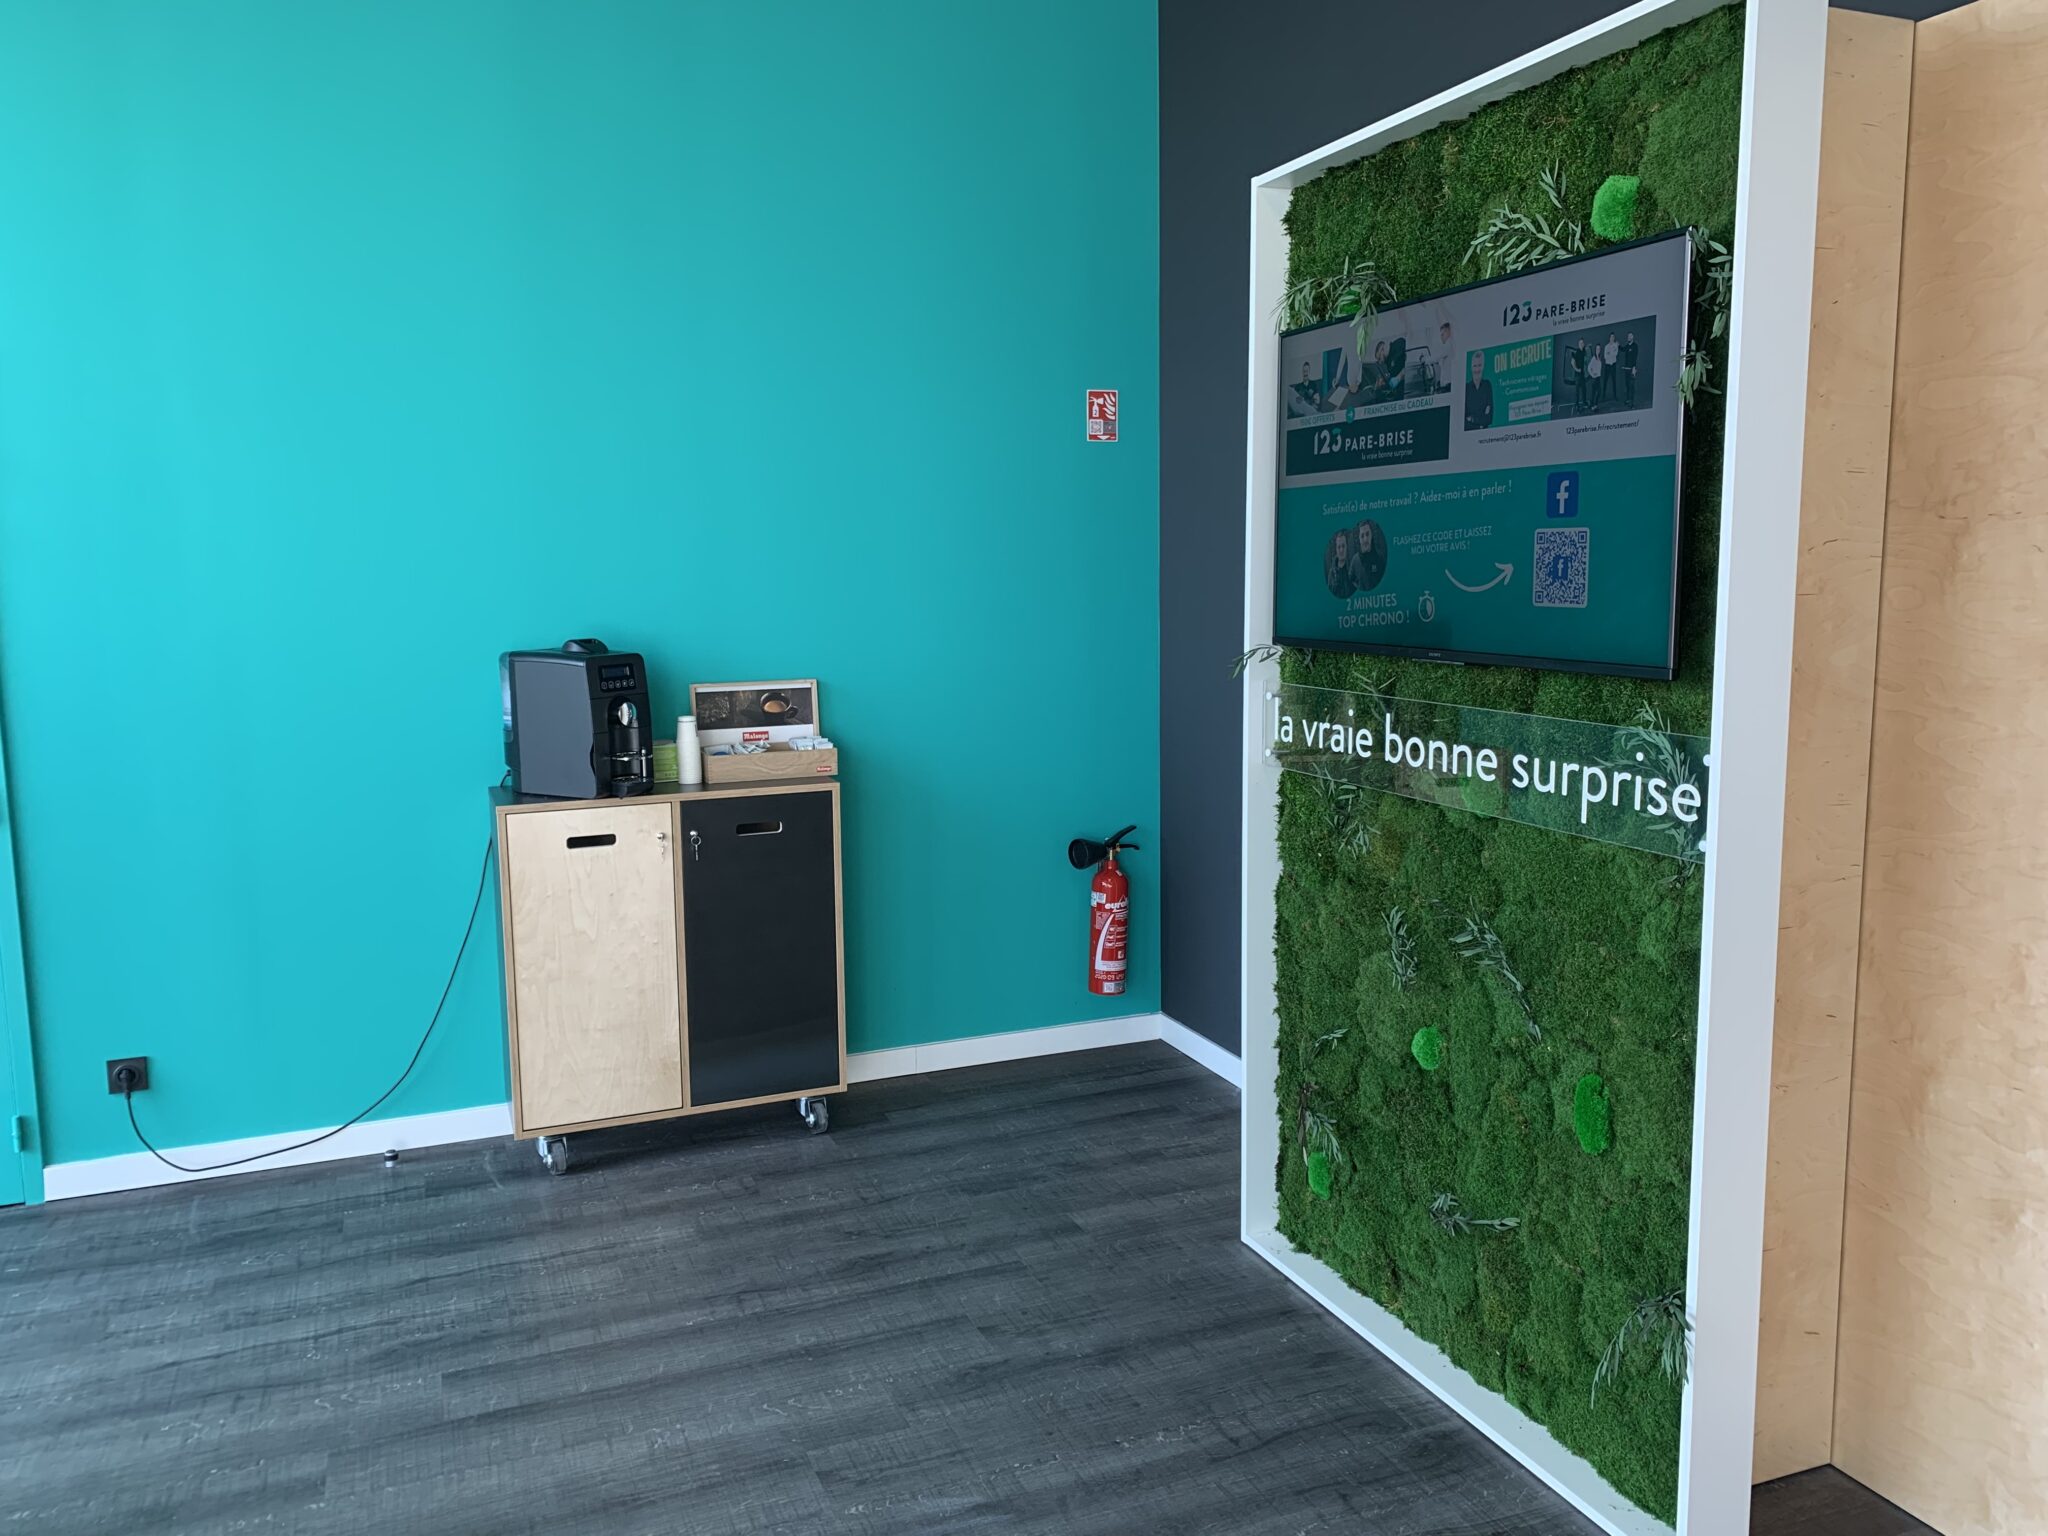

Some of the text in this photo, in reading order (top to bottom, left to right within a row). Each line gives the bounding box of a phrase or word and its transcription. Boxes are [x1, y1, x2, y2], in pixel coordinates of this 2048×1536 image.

[1536, 294, 1606, 320] PARE-BRISE
[1494, 338, 1552, 374] ON RECRUTE
[1363, 401, 1397, 416] FRANCHISE
[1407, 396, 1434, 409] CADEAU
[1345, 429, 1414, 452] PARE-BRISE
[1322, 500, 1358, 516] Satisfait(e)
[1359, 500, 1368, 511] de
[1369, 499, 1388, 510] notre
[1389, 492, 1412, 506] travail
[1420, 487, 1460, 503] Aidez-moi
[1462, 486, 1467, 498] à
[1469, 488, 1479, 498] en
[1481, 481, 1506, 501] parler
[1393, 525, 1492, 546] FLASHEZ CE CODE ET LAISSEZ
[1411, 544, 1424, 555] MOI
[1425, 541, 1449, 553] VOTRE
[1449, 540, 1466, 551] AVIS
[1346, 593, 1397, 611] 2 MINUTES
[1338, 615, 1356, 629] TOP
[1358, 610, 1404, 627] CHRONO
[1274, 696, 1701, 824] la vraie bonne surprise
